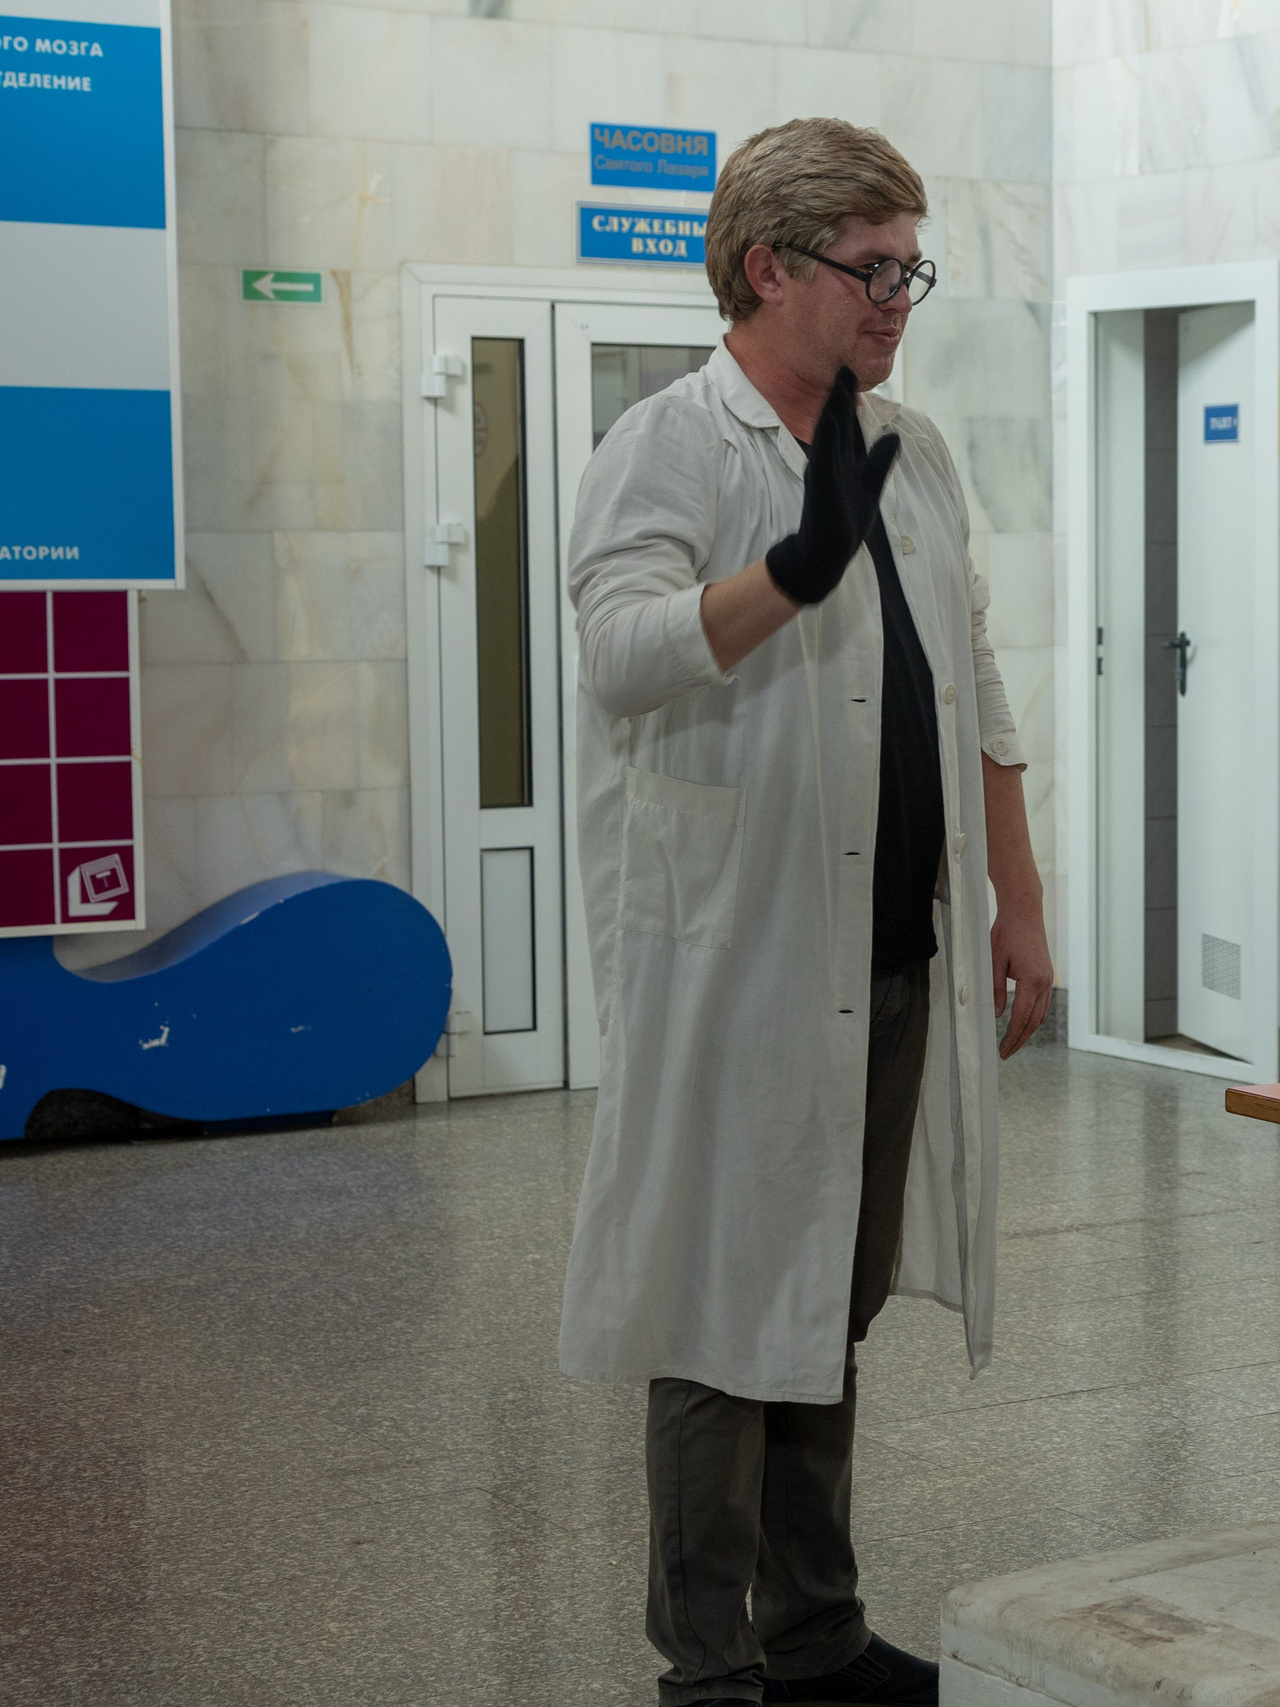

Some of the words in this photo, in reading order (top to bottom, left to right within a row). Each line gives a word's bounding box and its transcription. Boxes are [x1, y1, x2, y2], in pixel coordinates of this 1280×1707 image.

[0, 35, 28, 52] ГО
[35, 37, 104, 57] МОЗГА
[0, 70, 92, 92] ДЕЛЕНИЕ
[594, 127, 708, 156] ЧАСОВНЯ
[631, 236, 689, 259] ВХОД
